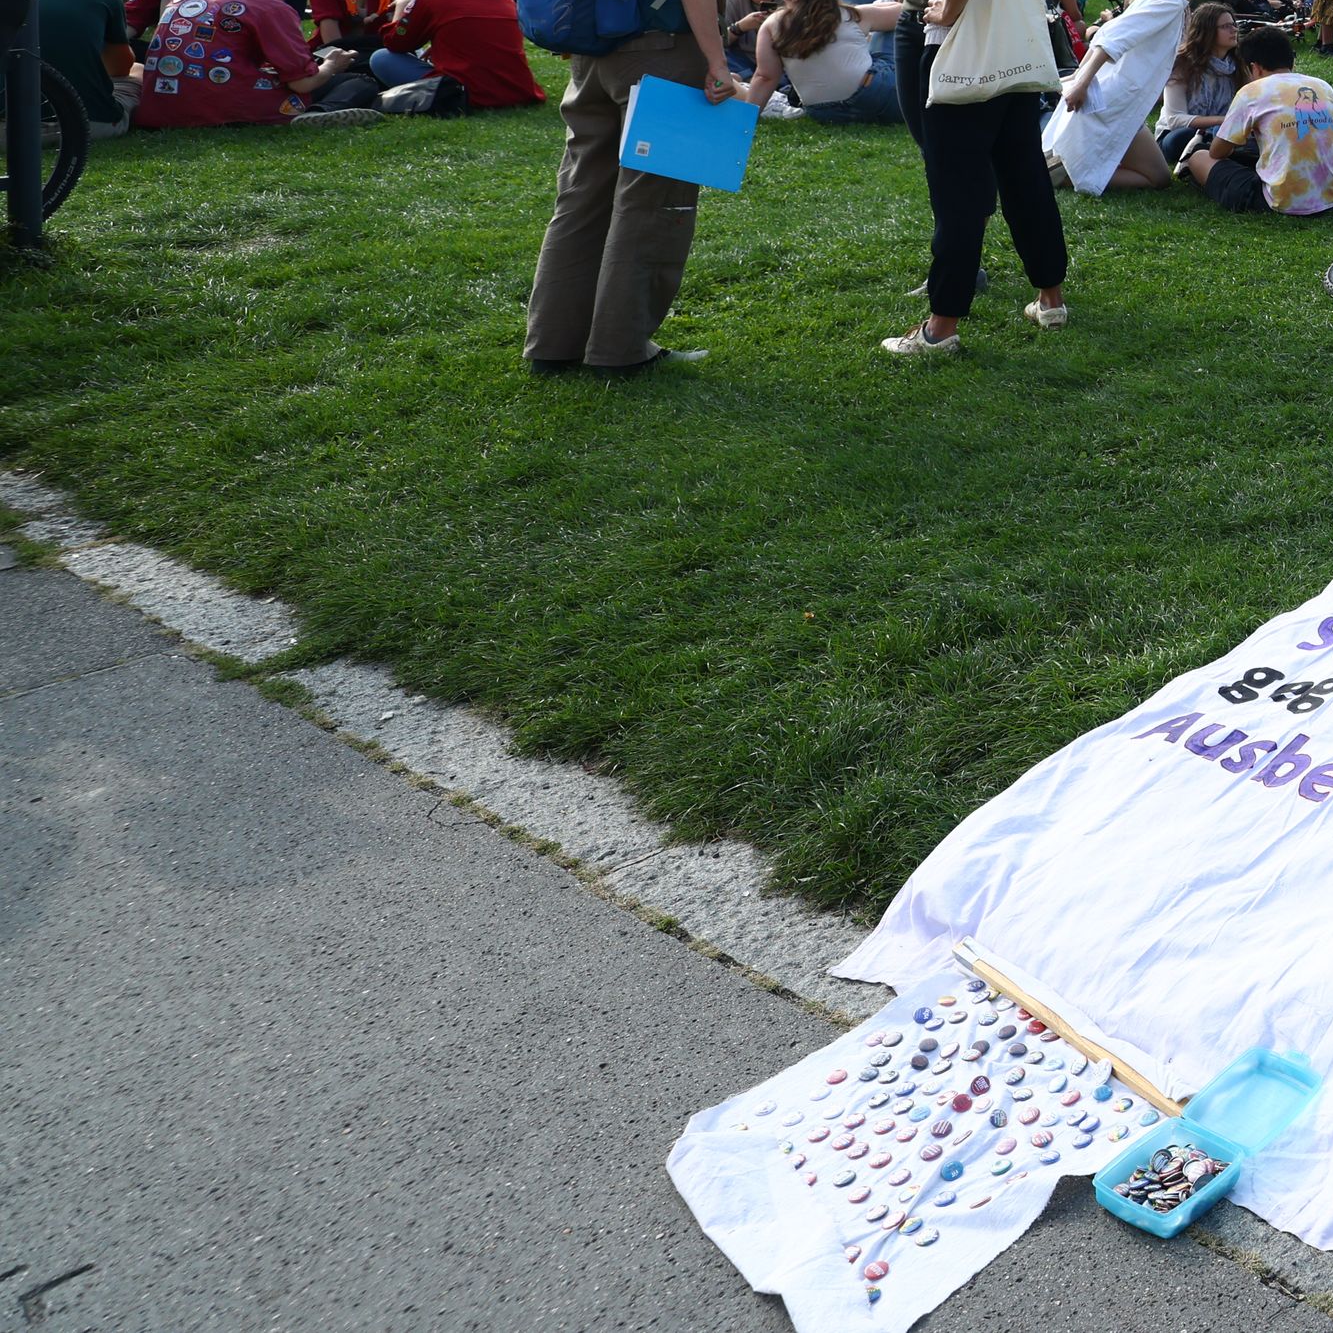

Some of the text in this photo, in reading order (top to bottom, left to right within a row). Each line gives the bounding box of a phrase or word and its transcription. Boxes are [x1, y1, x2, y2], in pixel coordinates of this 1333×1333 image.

[938, 73, 976, 87] Carry
[979, 74, 996, 84] me
[998, 62, 1032, 79] home
